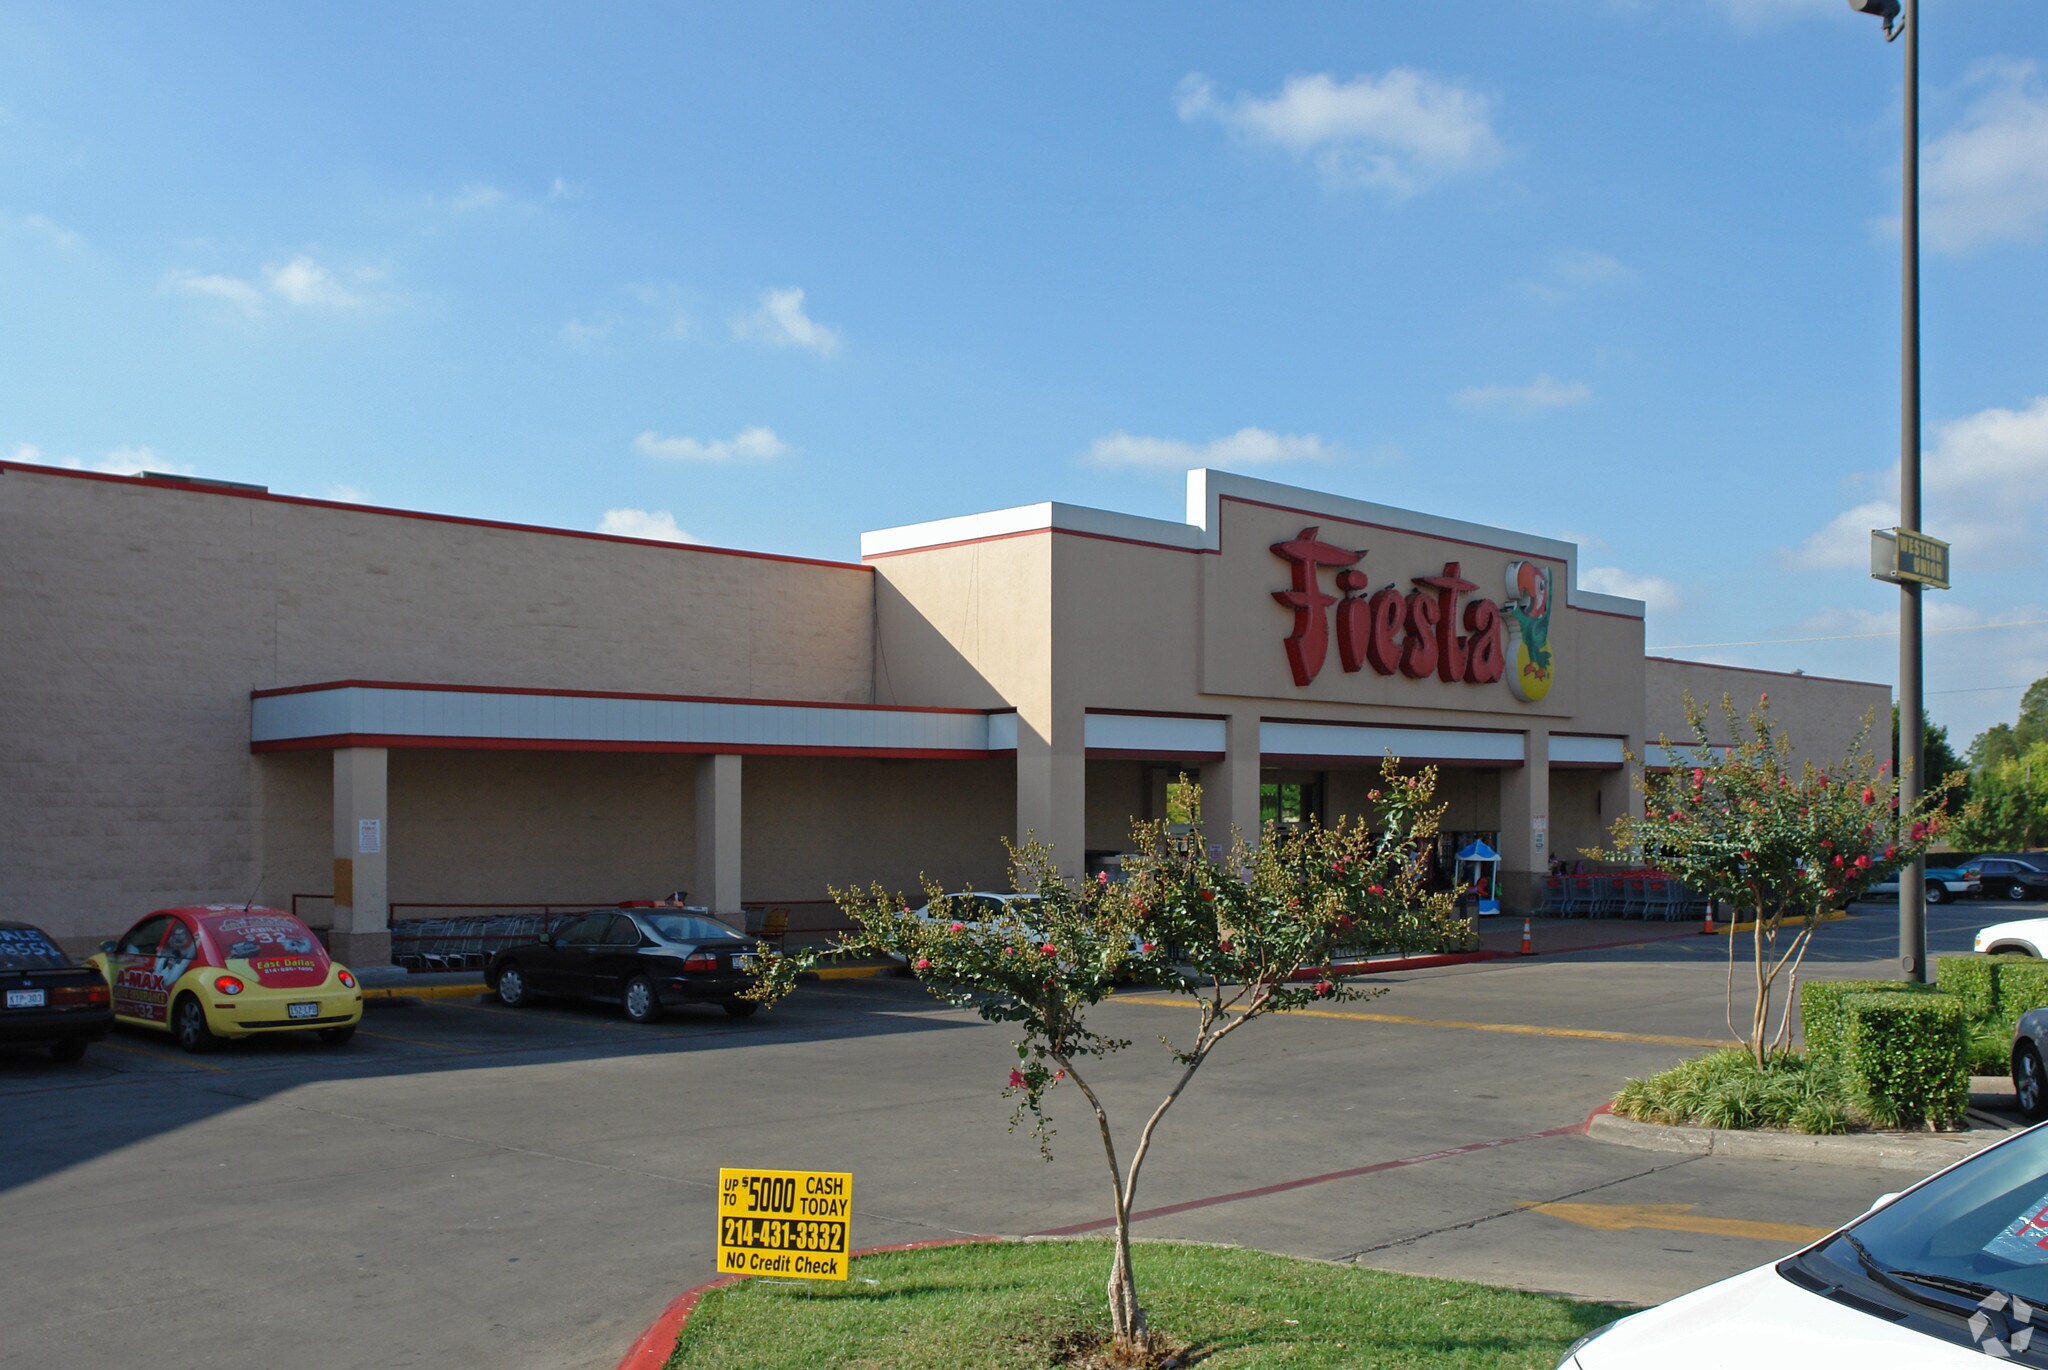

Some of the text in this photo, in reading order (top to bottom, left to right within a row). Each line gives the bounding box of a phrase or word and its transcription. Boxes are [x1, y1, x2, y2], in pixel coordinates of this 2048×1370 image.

[1899, 535, 1943, 561] WESTERN
[1913, 556, 1943, 580] UNION
[1269, 526, 1506, 687] Fiesta
[0, 930, 41, 941] ALE
[237, 927, 293, 936] LIABILITY
[256, 959, 315, 970] East Dallas
[116, 969, 165, 991] A-MAX
[723, 1192, 848, 1217] TO TODAY
[724, 1175, 844, 1213] UP $5000 CASH
[724, 1218, 842, 1251] 214-431-3332
[726, 1251, 838, 1275] NO Credit Check
